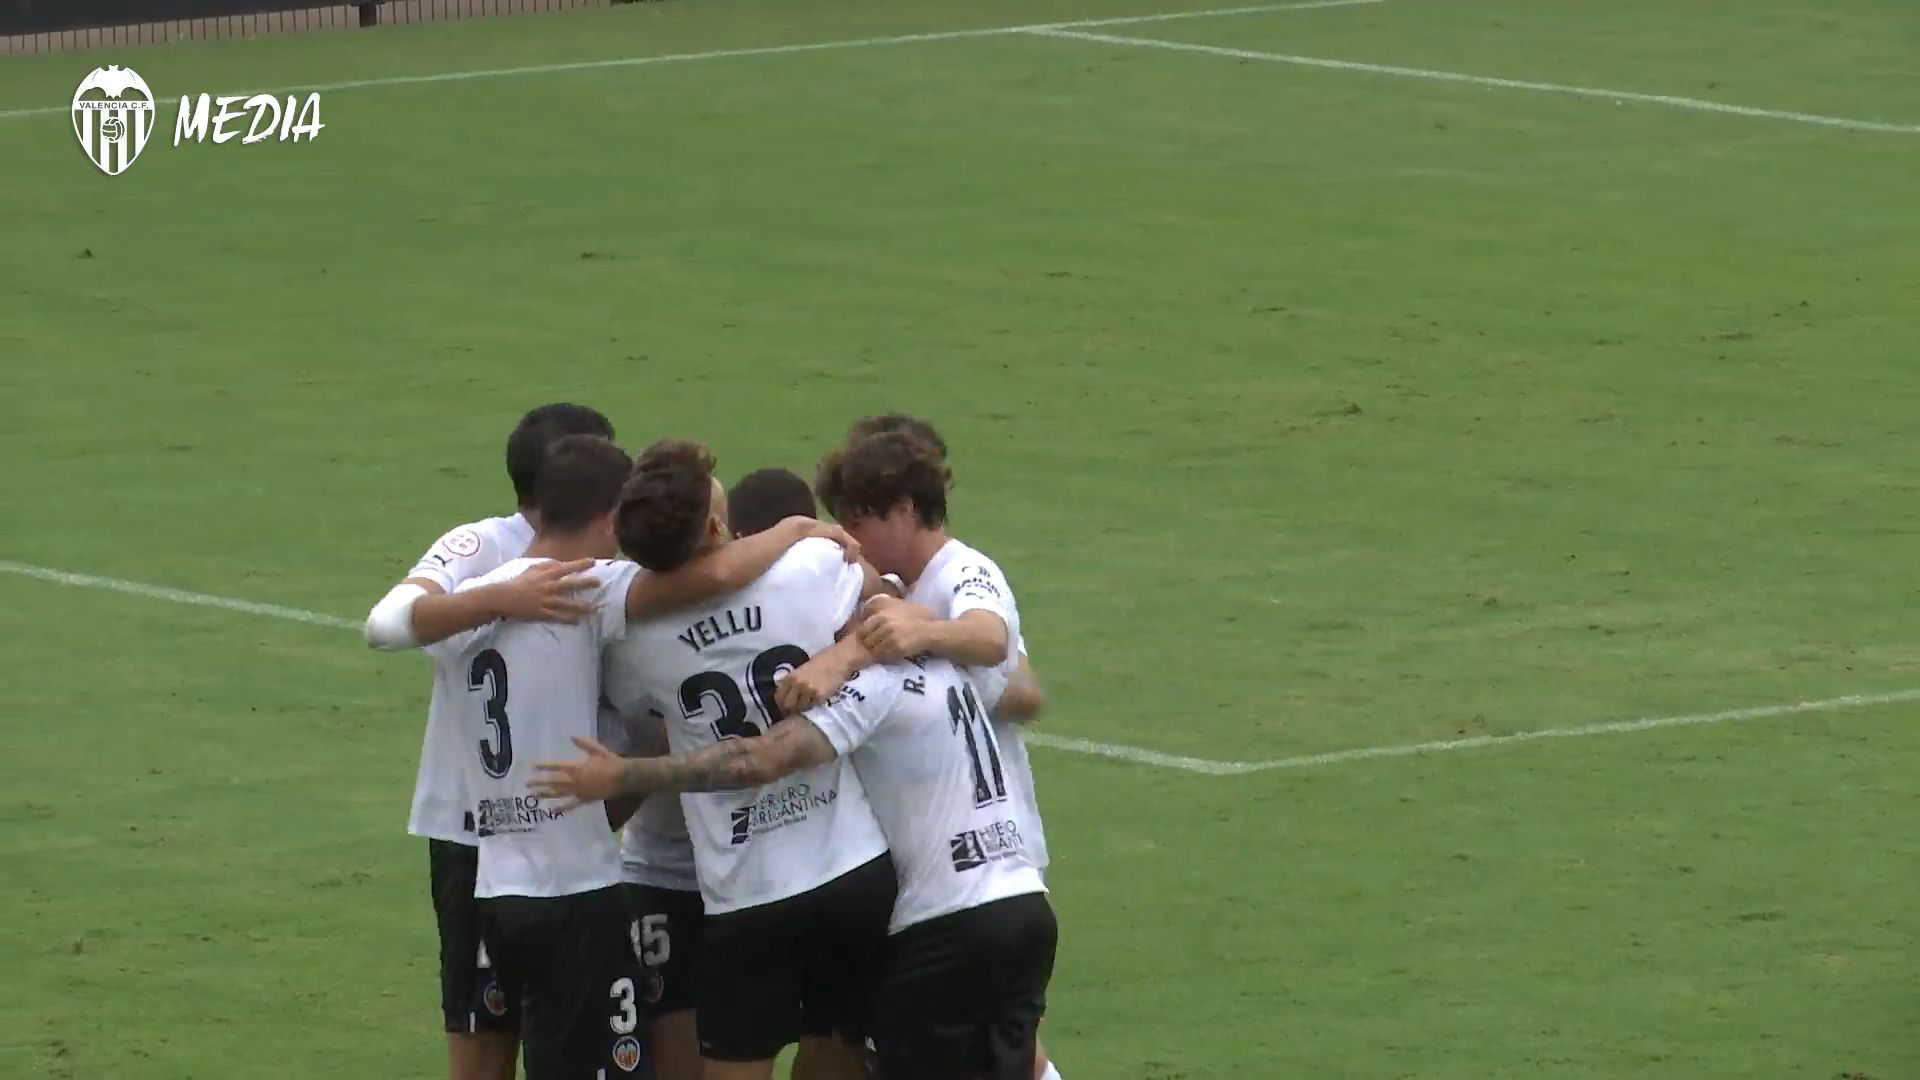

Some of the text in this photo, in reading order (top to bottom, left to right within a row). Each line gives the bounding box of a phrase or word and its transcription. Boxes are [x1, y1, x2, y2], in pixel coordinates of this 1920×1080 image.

[678, 606, 762, 653] YELLU
[468, 648, 513, 779] 3
[946, 681, 1008, 810] 11
[610, 977, 637, 1034] 3
